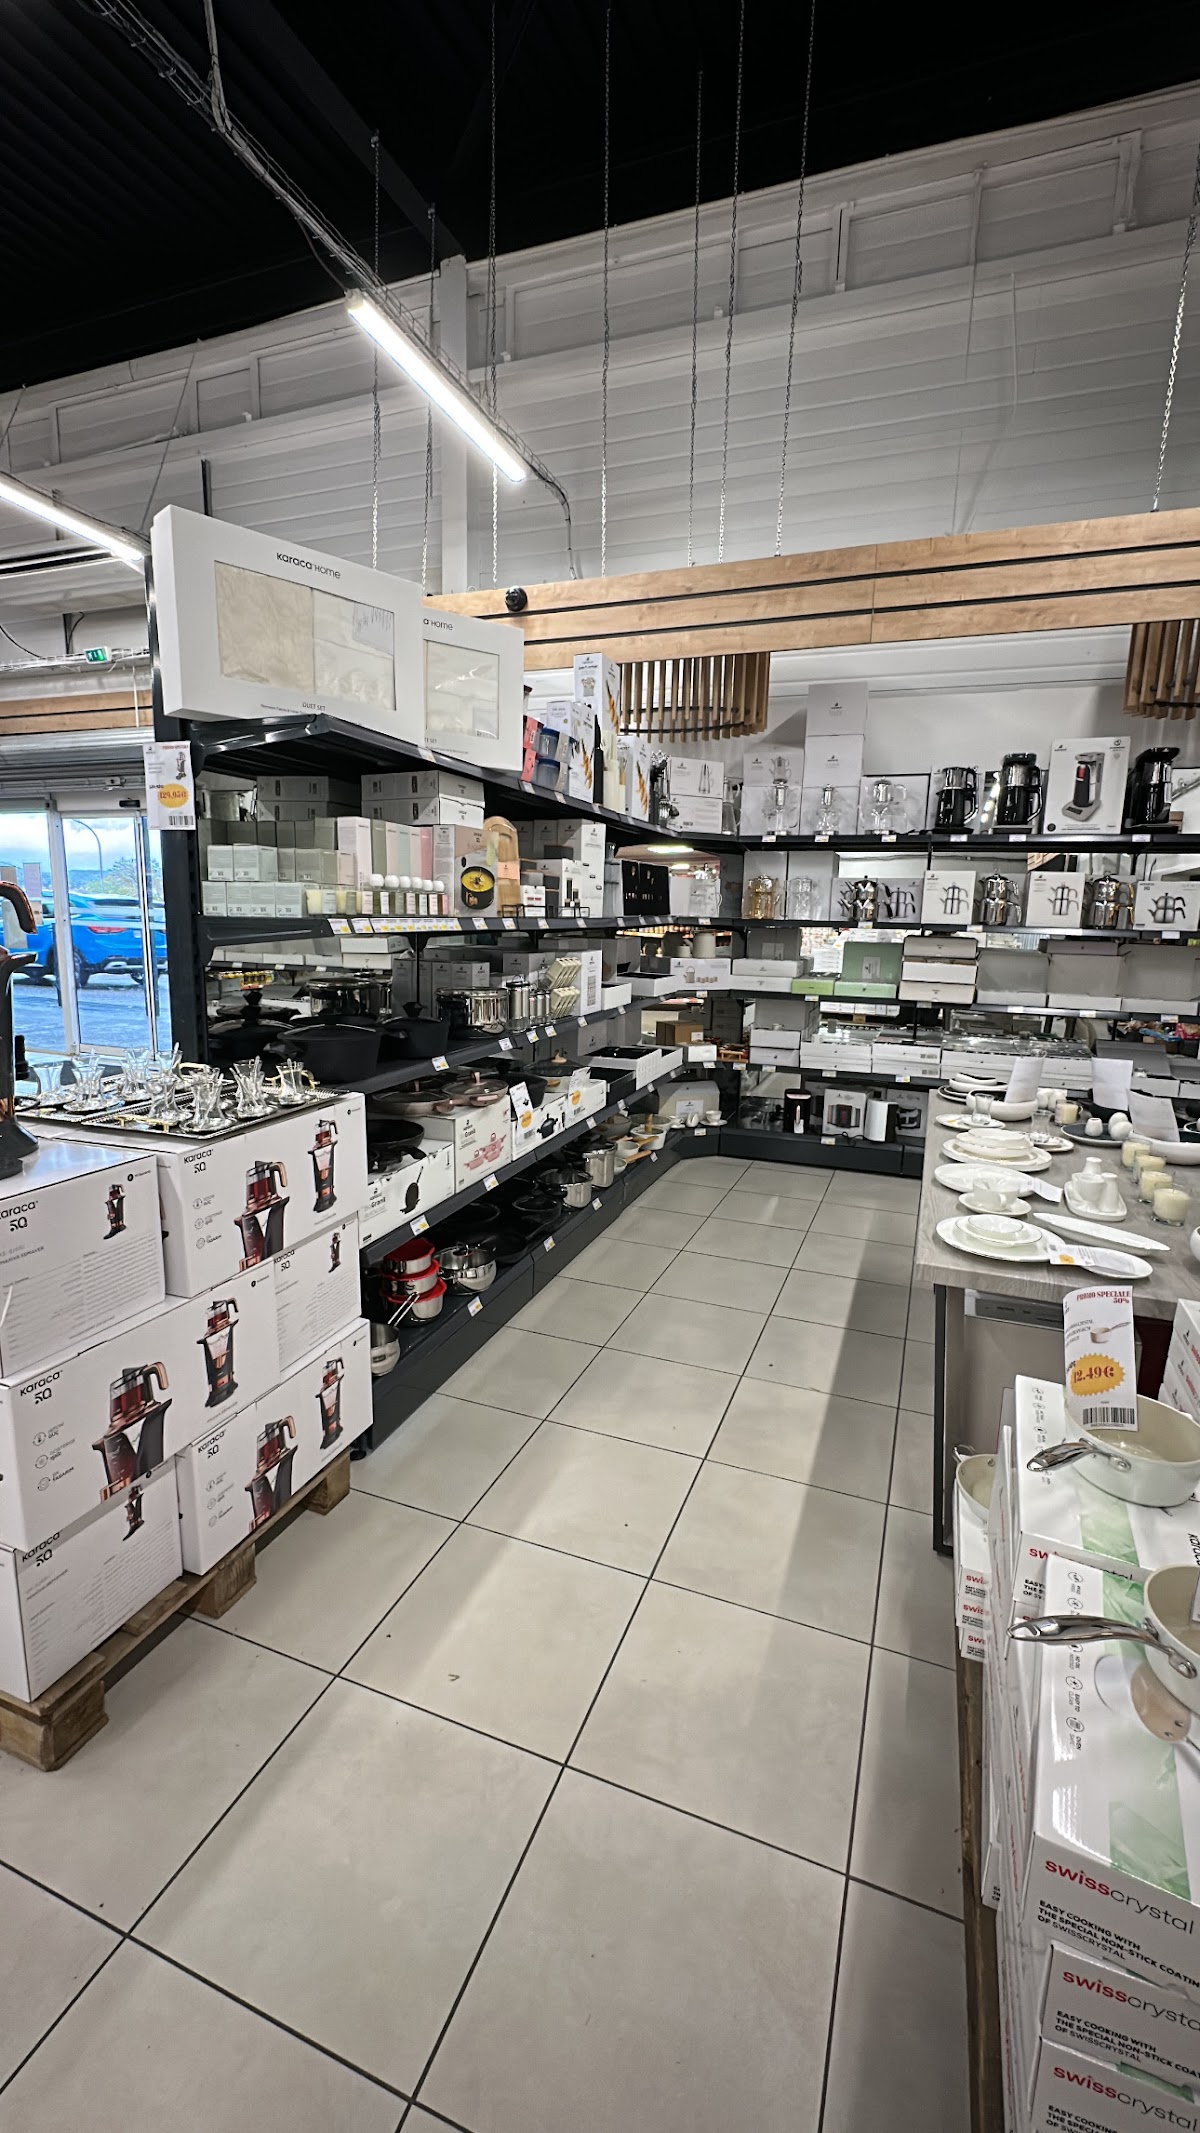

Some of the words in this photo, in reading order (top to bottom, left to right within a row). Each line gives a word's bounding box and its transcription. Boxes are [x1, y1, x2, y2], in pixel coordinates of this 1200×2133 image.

[183, 1150, 213, 1164] karaca
[1077, 1292, 1096, 1301] PROMO
[20, 1371, 61, 1396] karaca
[22, 1532, 60, 1562] karaca
[1045, 1859, 1195, 1934] swisscrystal
[1037, 1914, 1051, 1925] OF
[1052, 1921, 1126, 1961] SWISSCRYSTAL
[1038, 1907, 1057, 1920] THE
[1059, 1914, 1099, 1940] SPECIAL
[1101, 1934, 1157, 1968] NON-STICK
[1039, 1900, 1065, 1915] EASY
[1066, 1912, 1112, 1937] COOKING
[1114, 1933, 1141, 1951] WITH
[1054, 2025, 1069, 2035] OF
[1070, 2030, 1141, 2062] SWISSCRYSTAL
[1055, 2017, 1075, 2029] THE
[1076, 2023, 1116, 2045] SPECIAL
[1118, 2041, 1173, 2068] NON-STICK
[1056, 2010, 1082, 2024] EASY
[1084, 2020, 1129, 2042] COOKING
[1130, 2038, 1157, 2053] WITH
[1048, 2104, 1074, 2119] EASY
[1054, 2066, 1198, 2132] swisscrystal
[1046, 2120, 1059, 2129] OF
[1047, 2112, 1066, 2124] THE
